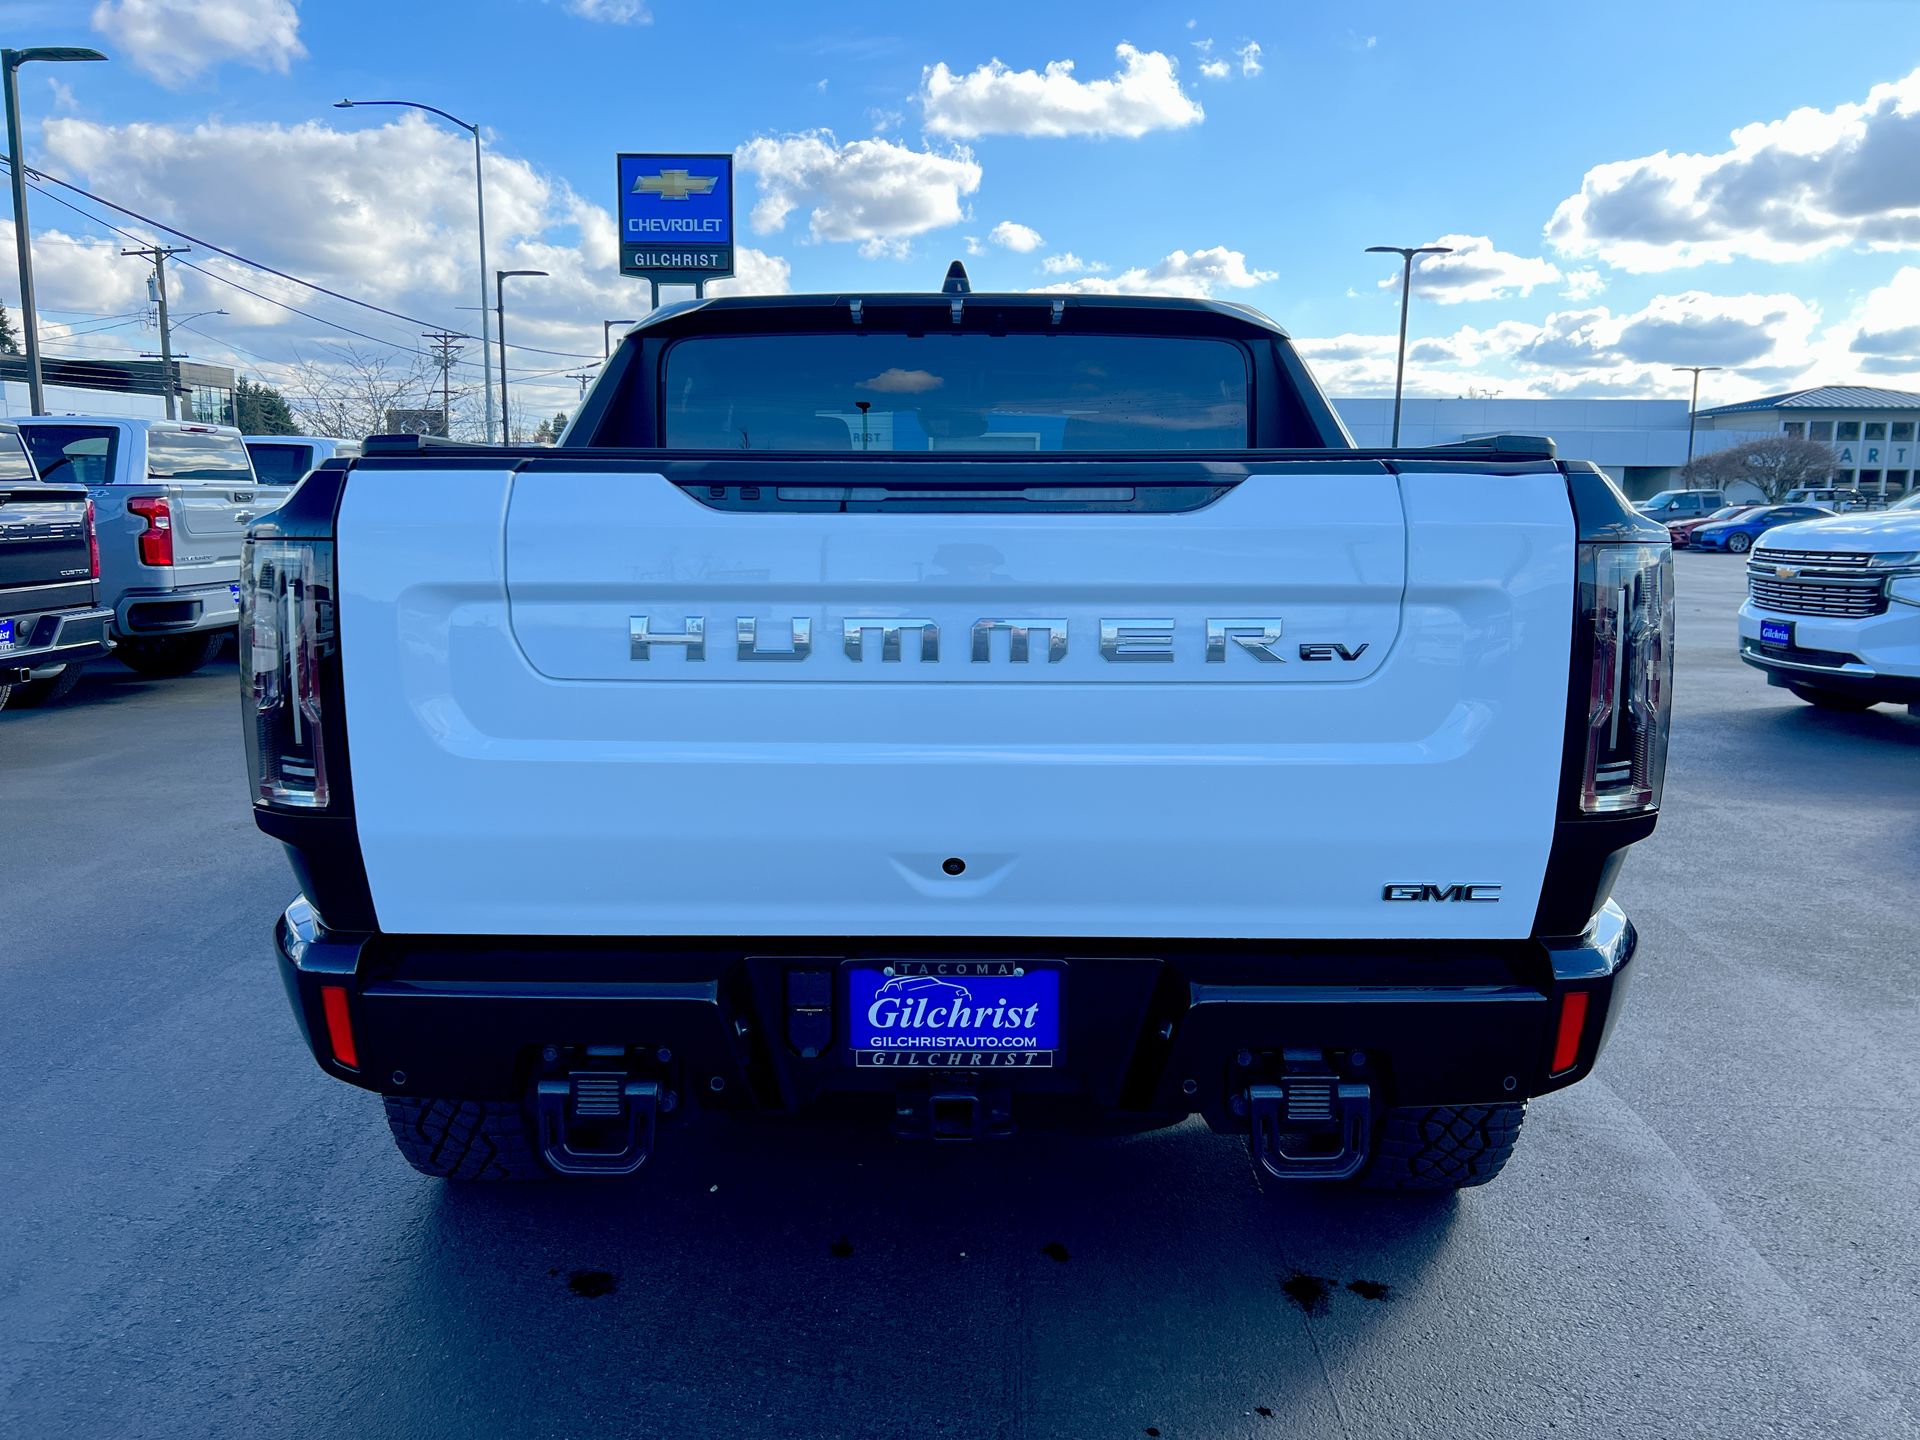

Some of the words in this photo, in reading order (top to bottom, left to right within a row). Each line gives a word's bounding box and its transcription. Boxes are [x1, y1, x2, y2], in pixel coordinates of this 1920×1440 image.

[628, 218, 723, 232] CHEVROLET
[634, 253, 719, 267] GILCHRIST
[629, 615, 1287, 663] HUMMER
[1299, 643, 1370, 662] EV
[1382, 882, 1502, 902] GMC
[901, 963, 1009, 975] TACOMA
[868, 997, 1039, 1028] Gilchrist
[870, 1036, 1037, 1048] GILCHRISTAUTO.COM
[872, 1052, 1038, 1065] GILCHRIST
